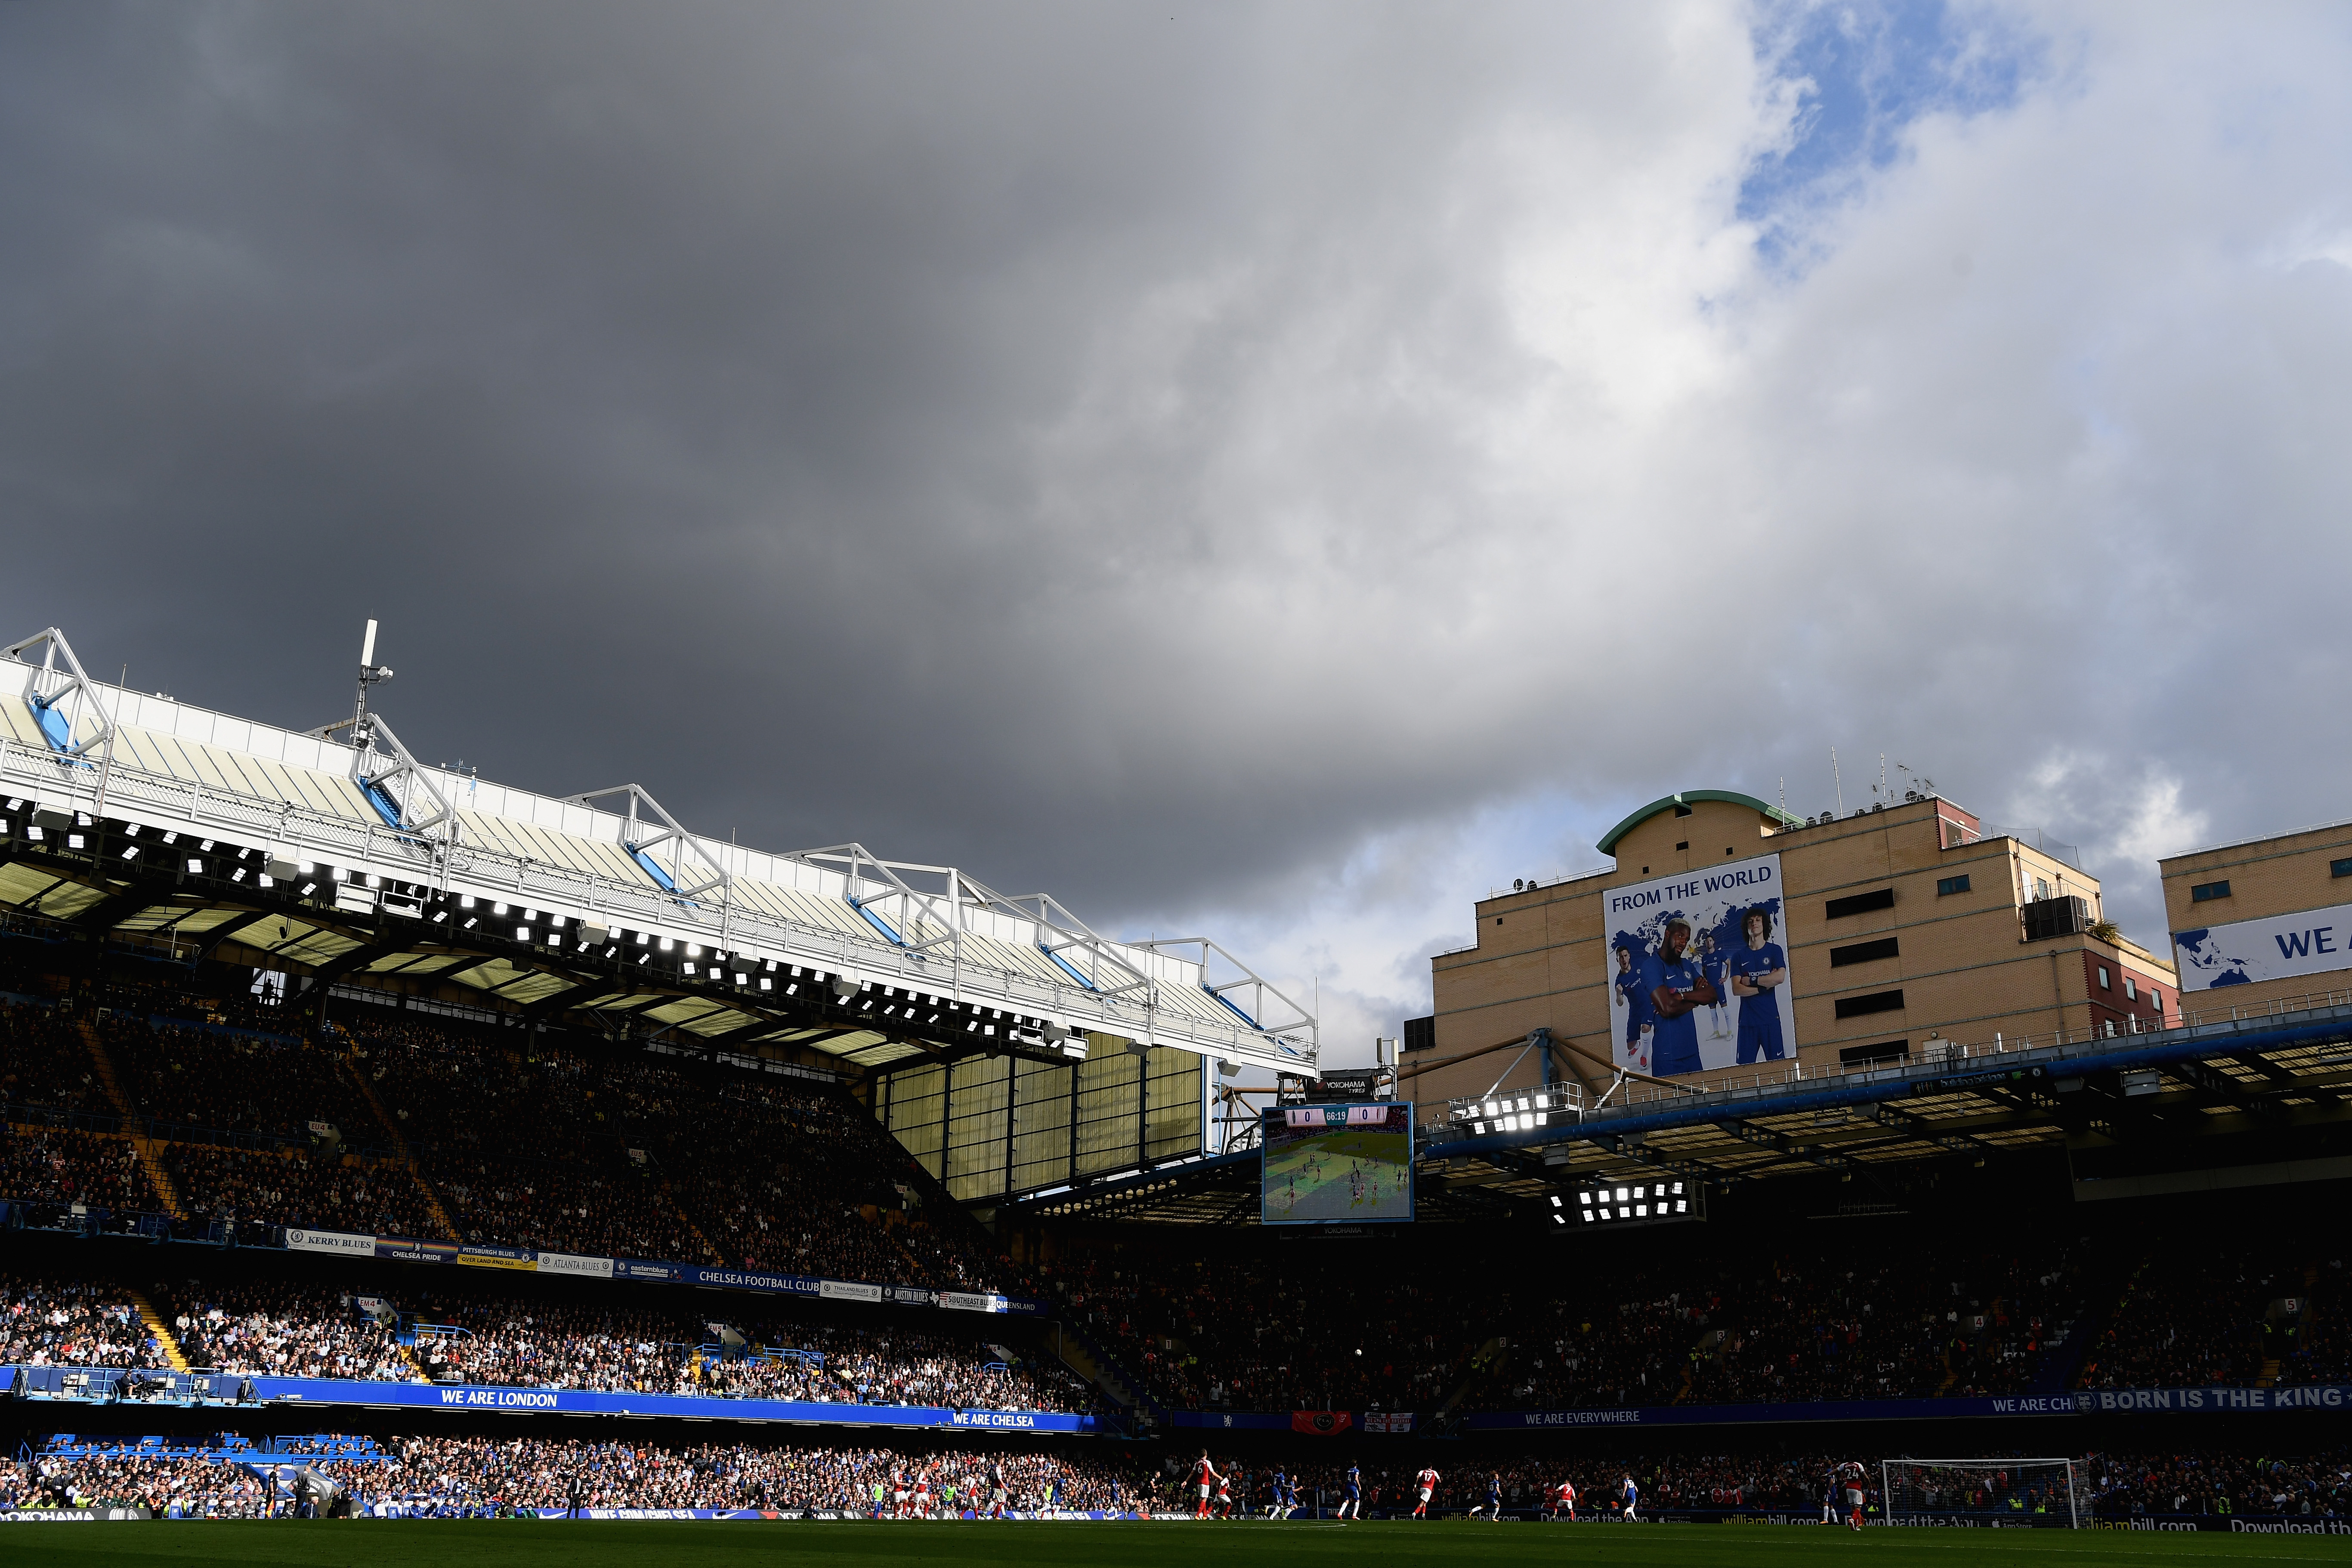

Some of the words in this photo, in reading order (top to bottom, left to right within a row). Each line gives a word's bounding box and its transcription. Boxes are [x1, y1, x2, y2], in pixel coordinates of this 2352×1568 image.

[1612, 890, 1661, 912] FROM
[1665, 881, 1700, 900] THE
[1704, 866, 1771, 893] WORLD
[2275, 927, 2337, 959] WE
[1305, 1111, 1310, 1122] 0
[1326, 1111, 1346, 1121] 66:19
[1362, 1109, 1368, 1120] 0
[308, 1236, 342, 1246] KERRY
[342, 1239, 371, 1249] BLUES
[392, 1251, 420, 1259] CHELSEA
[463, 1247, 497, 1256] PITTSBURGH
[553, 1259, 580, 1270] ATLANTA
[582, 1262, 599, 1271] BLUES
[630, 1265, 668, 1274] easternblues
[699, 1271, 743, 1285] CHELSEA
[745, 1276, 794, 1290] FOOTBALL
[796, 1280, 819, 1292] CLUB
[895, 1290, 912, 1301] AUSTIN
[913, 1291, 928, 1302] BLUES
[949, 1296, 979, 1305] SOUTHEAST
[996, 1300, 1035, 1311] QUEENSLAND
[2288, 1300, 2294, 1309] 5
[442, 1390, 464, 1404] WE
[467, 1392, 495, 1405] ARE
[499, 1392, 557, 1407] LONDON
[1993, 1399, 2015, 1411] WE
[2019, 1398, 2047, 1411] ARE
[2100, 1391, 2170, 1409] BORN
[2179, 1390, 2203, 1408] IS
[2212, 1389, 2265, 1407] THE
[2275, 1389, 2342, 1407] KING
[953, 1413, 970, 1424] WE
[971, 1414, 991, 1426] ARE
[992, 1415, 1034, 1427] CHELSEA
[1526, 1413, 1541, 1424] WE
[1544, 1413, 1564, 1424] ARE
[1567, 1411, 1640, 1423] EVERYWHERE
[1198, 1465, 1203, 1473] 6
[1845, 1468, 1859, 1479] 24
[1425, 1472, 1433, 1481] 17
[0, 1511, 94, 1521] YOKOHAMA
[1442, 1512, 1520, 1521] williamhillcom
[1602, 1513, 1622, 1522] the
[1722, 1514, 1819, 1525] williamhillcom
[1921, 1515, 1945, 1527] the
[2231, 1519, 2325, 1534] Download
[2329, 1520, 2352, 1535] th
